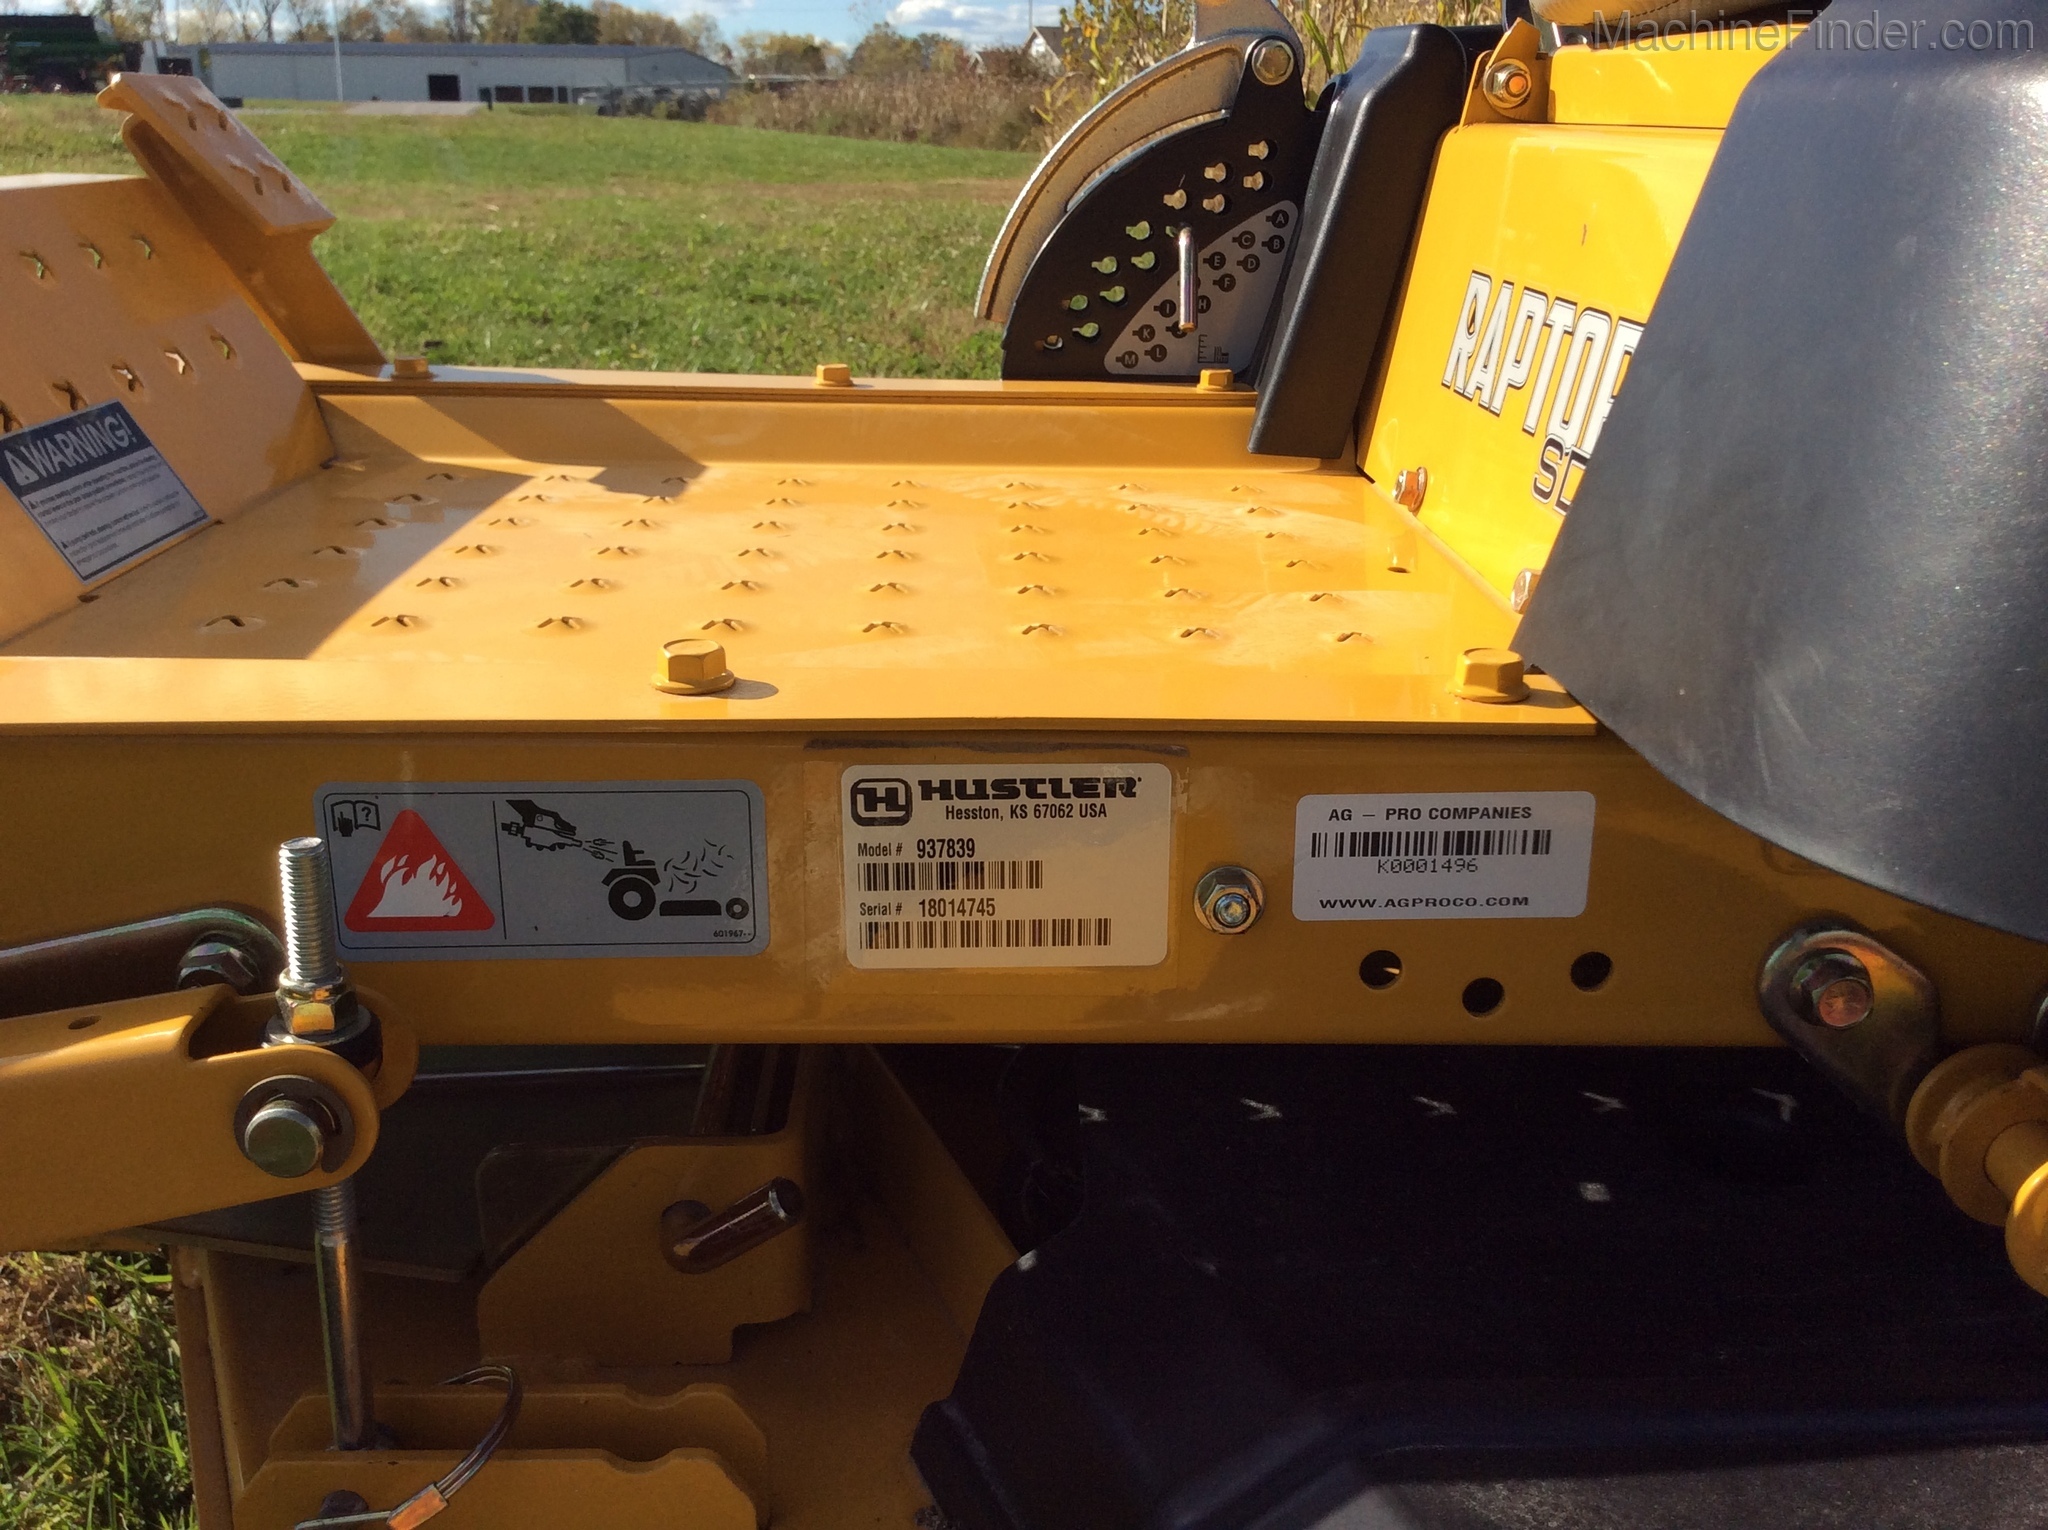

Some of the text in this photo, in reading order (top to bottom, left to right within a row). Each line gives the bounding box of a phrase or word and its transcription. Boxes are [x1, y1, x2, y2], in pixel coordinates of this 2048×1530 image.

[20, 412, 138, 478] WARNING!
[917, 776, 1139, 801] HUSTLER
[945, 802, 1108, 822] Hesston, KS 67062 USA
[1328, 808, 1353, 821] AG
[1385, 807, 1422, 821] PRO
[1428, 806, 1532, 821] COMPANIES
[857, 837, 976, 859] Model # 937839
[1377, 857, 1479, 874] K0001496
[859, 897, 996, 918] Serial # 18014745
[1319, 896, 1530, 909] WWW.AGPROCO.COM
